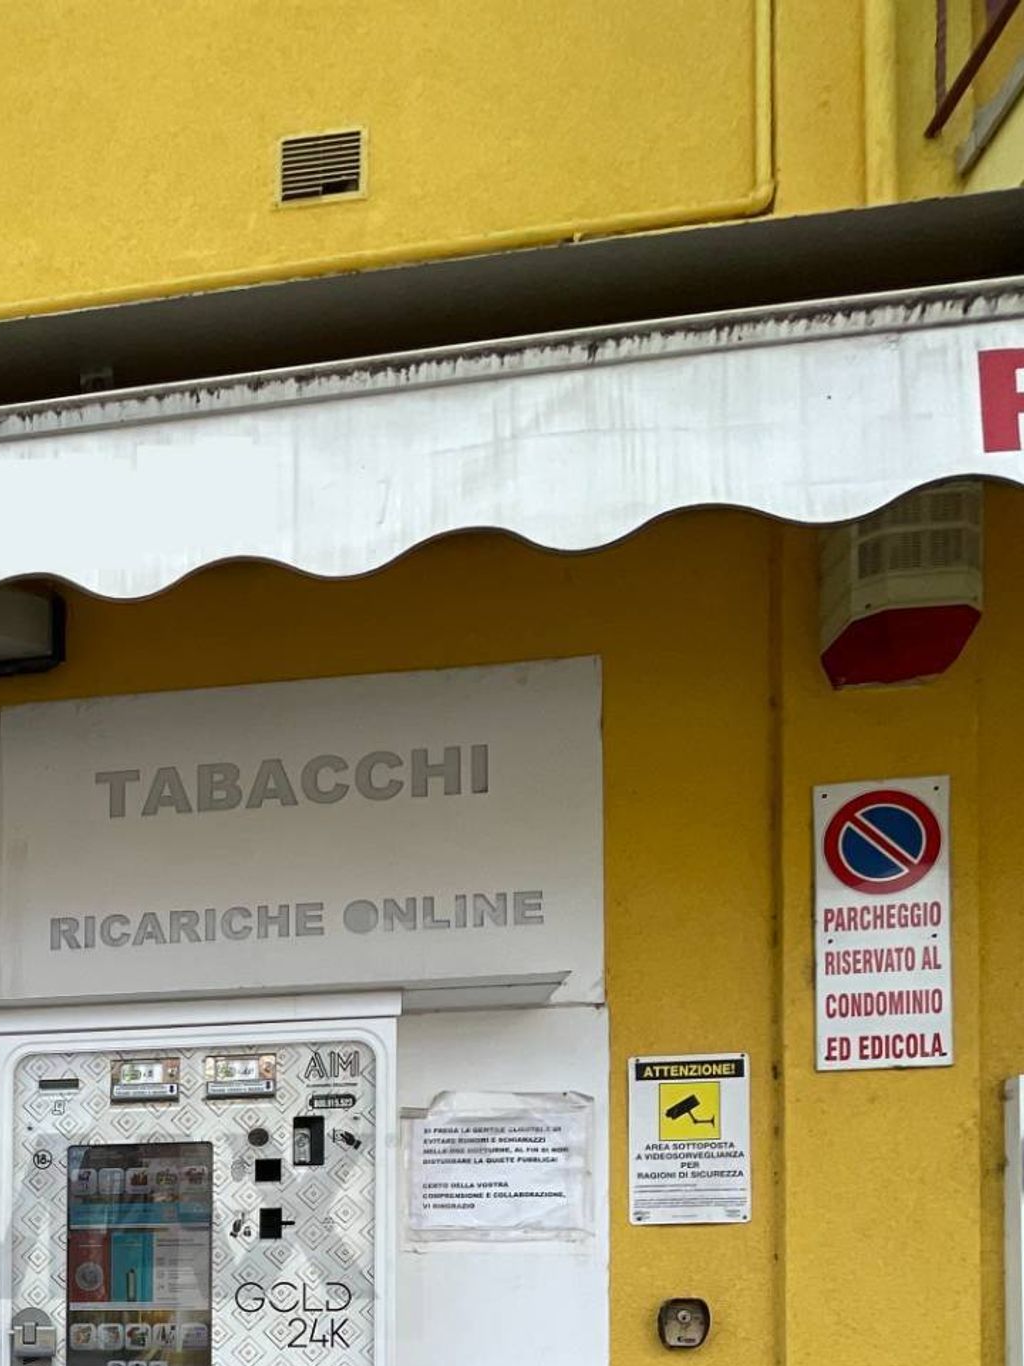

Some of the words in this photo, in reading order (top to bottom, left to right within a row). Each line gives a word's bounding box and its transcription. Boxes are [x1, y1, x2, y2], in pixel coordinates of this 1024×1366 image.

[95, 744, 489, 819] TABACCHI
[50, 902, 324, 950] RICARICHE
[342, 890, 544, 934] ONLINE
[824, 901, 941, 932] PARCHEGGIO
[825, 947, 916, 975] RISERVATO
[922, 946, 942, 970] AL
[826, 989, 943, 1019] CONDOMINIO
[827, 1036, 850, 1061] ED
[858, 1032, 943, 1060] EDICOLA
[644, 1063, 736, 1079] ATTENZIONE!
[636, 1153, 642, 1161] A
[644, 1151, 745, 1160] VIDEOSORVEGLIANZA
[645, 1143, 670, 1151] AREA
[672, 1142, 735, 1150] SOTTOPOSTA
[637, 1171, 676, 1179] RAGIONI
[678, 1171, 689, 1179] DI
[691, 1170, 744, 1178] SICUREZZA
[680, 1161, 700, 1169] PER
[235, 1282, 352, 1312] GOLD
[287, 1318, 351, 1349] 24K
